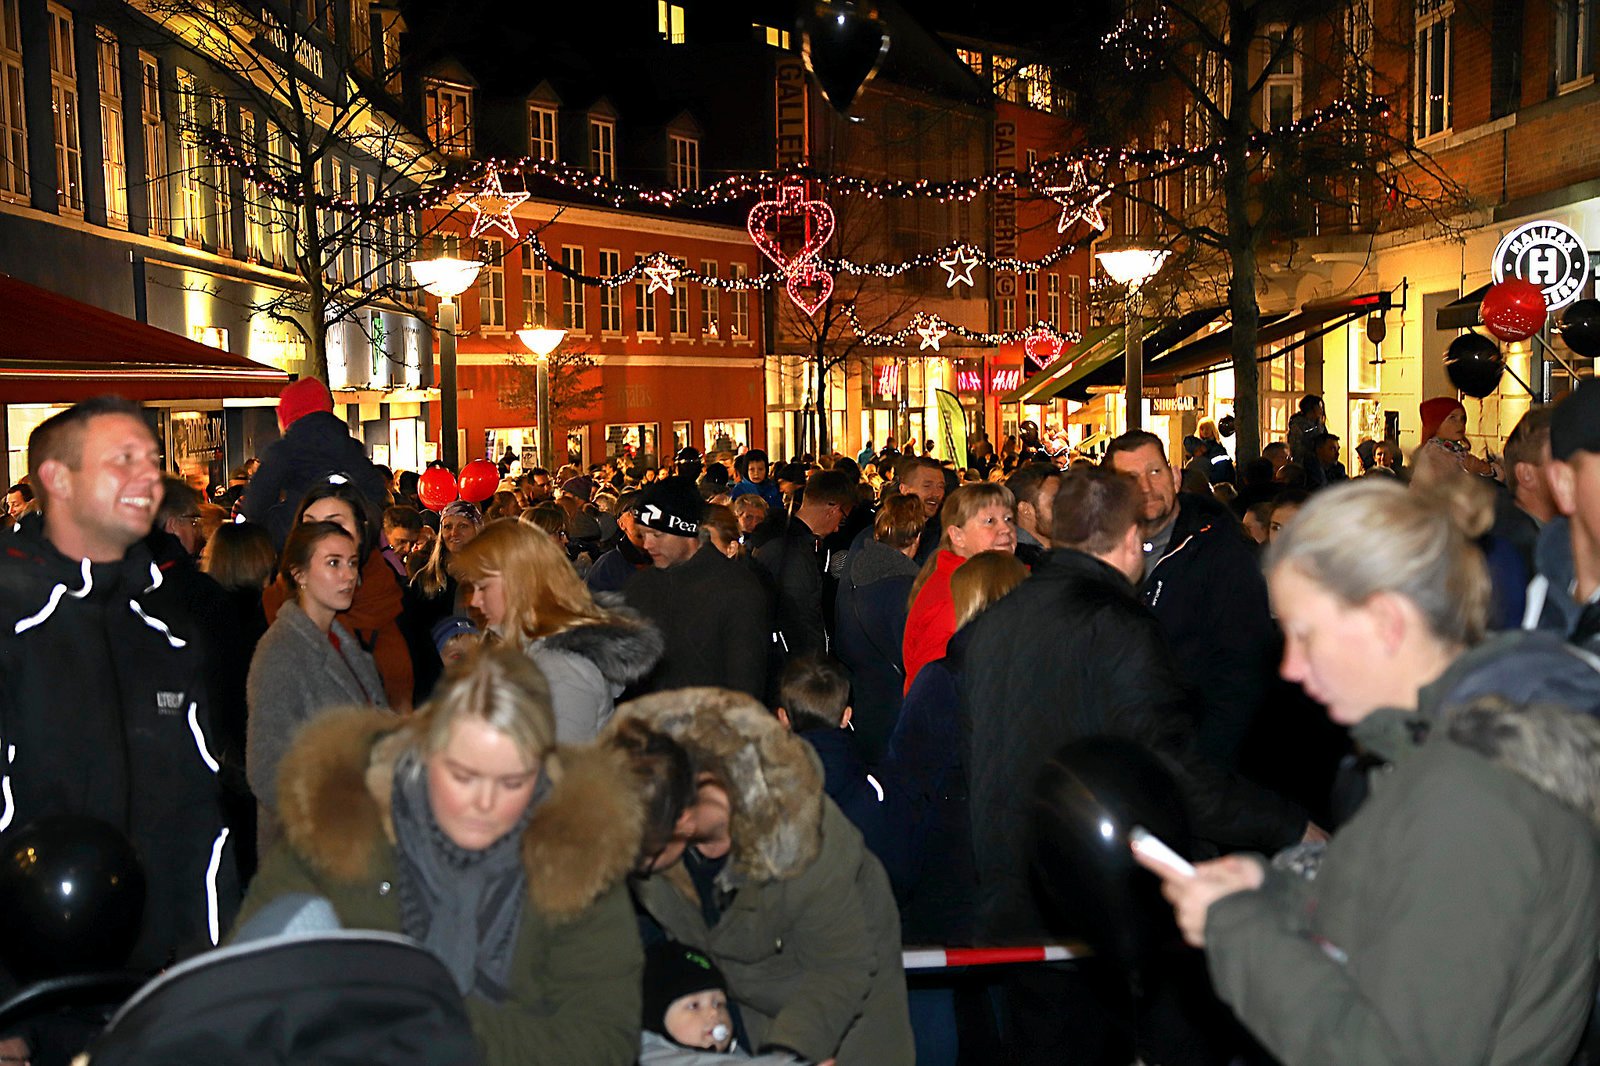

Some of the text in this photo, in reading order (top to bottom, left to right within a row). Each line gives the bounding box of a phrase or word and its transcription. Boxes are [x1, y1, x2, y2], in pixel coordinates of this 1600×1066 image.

[1509, 226, 1578, 254] HALIFAX
[1529, 248, 1558, 284] H
[992, 370, 1019, 391] H&M
[669, 514, 699, 533] Pea
